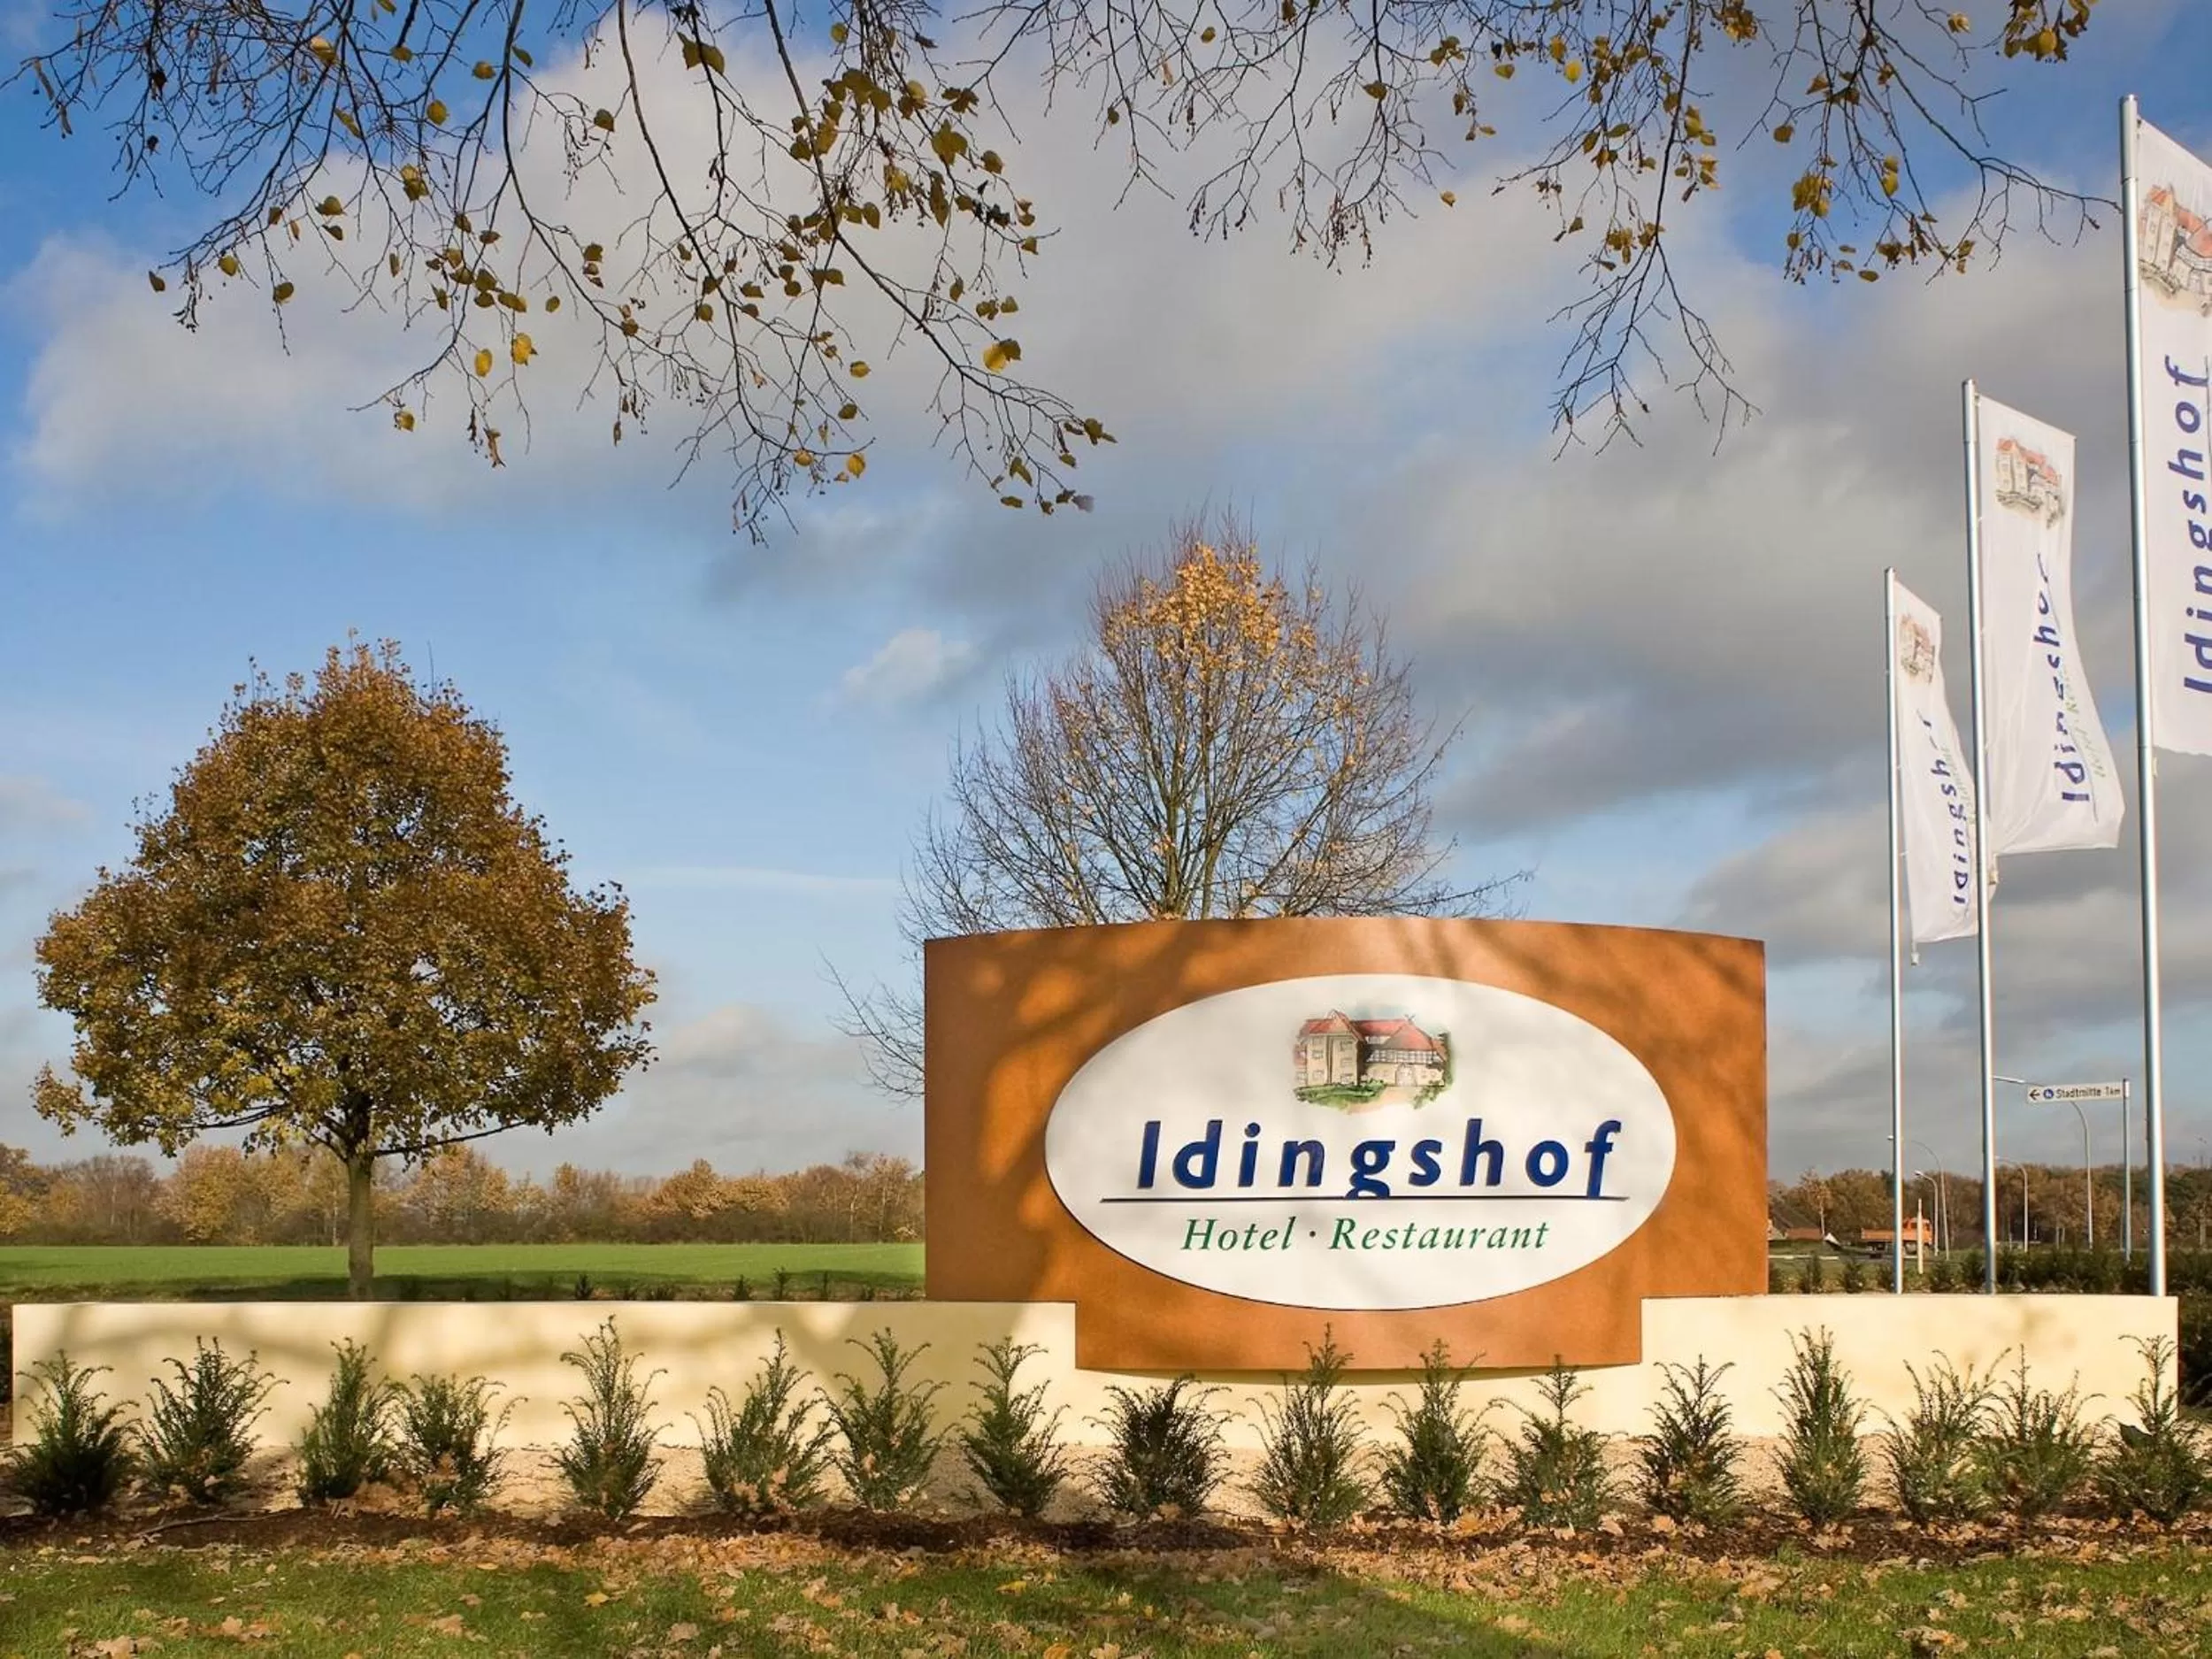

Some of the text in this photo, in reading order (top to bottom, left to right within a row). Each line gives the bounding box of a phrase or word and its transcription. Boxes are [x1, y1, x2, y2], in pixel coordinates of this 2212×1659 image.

[1137, 1118, 1622, 1200] Idingshof
[1181, 1217, 1550, 1251] Hotel Restaurant
